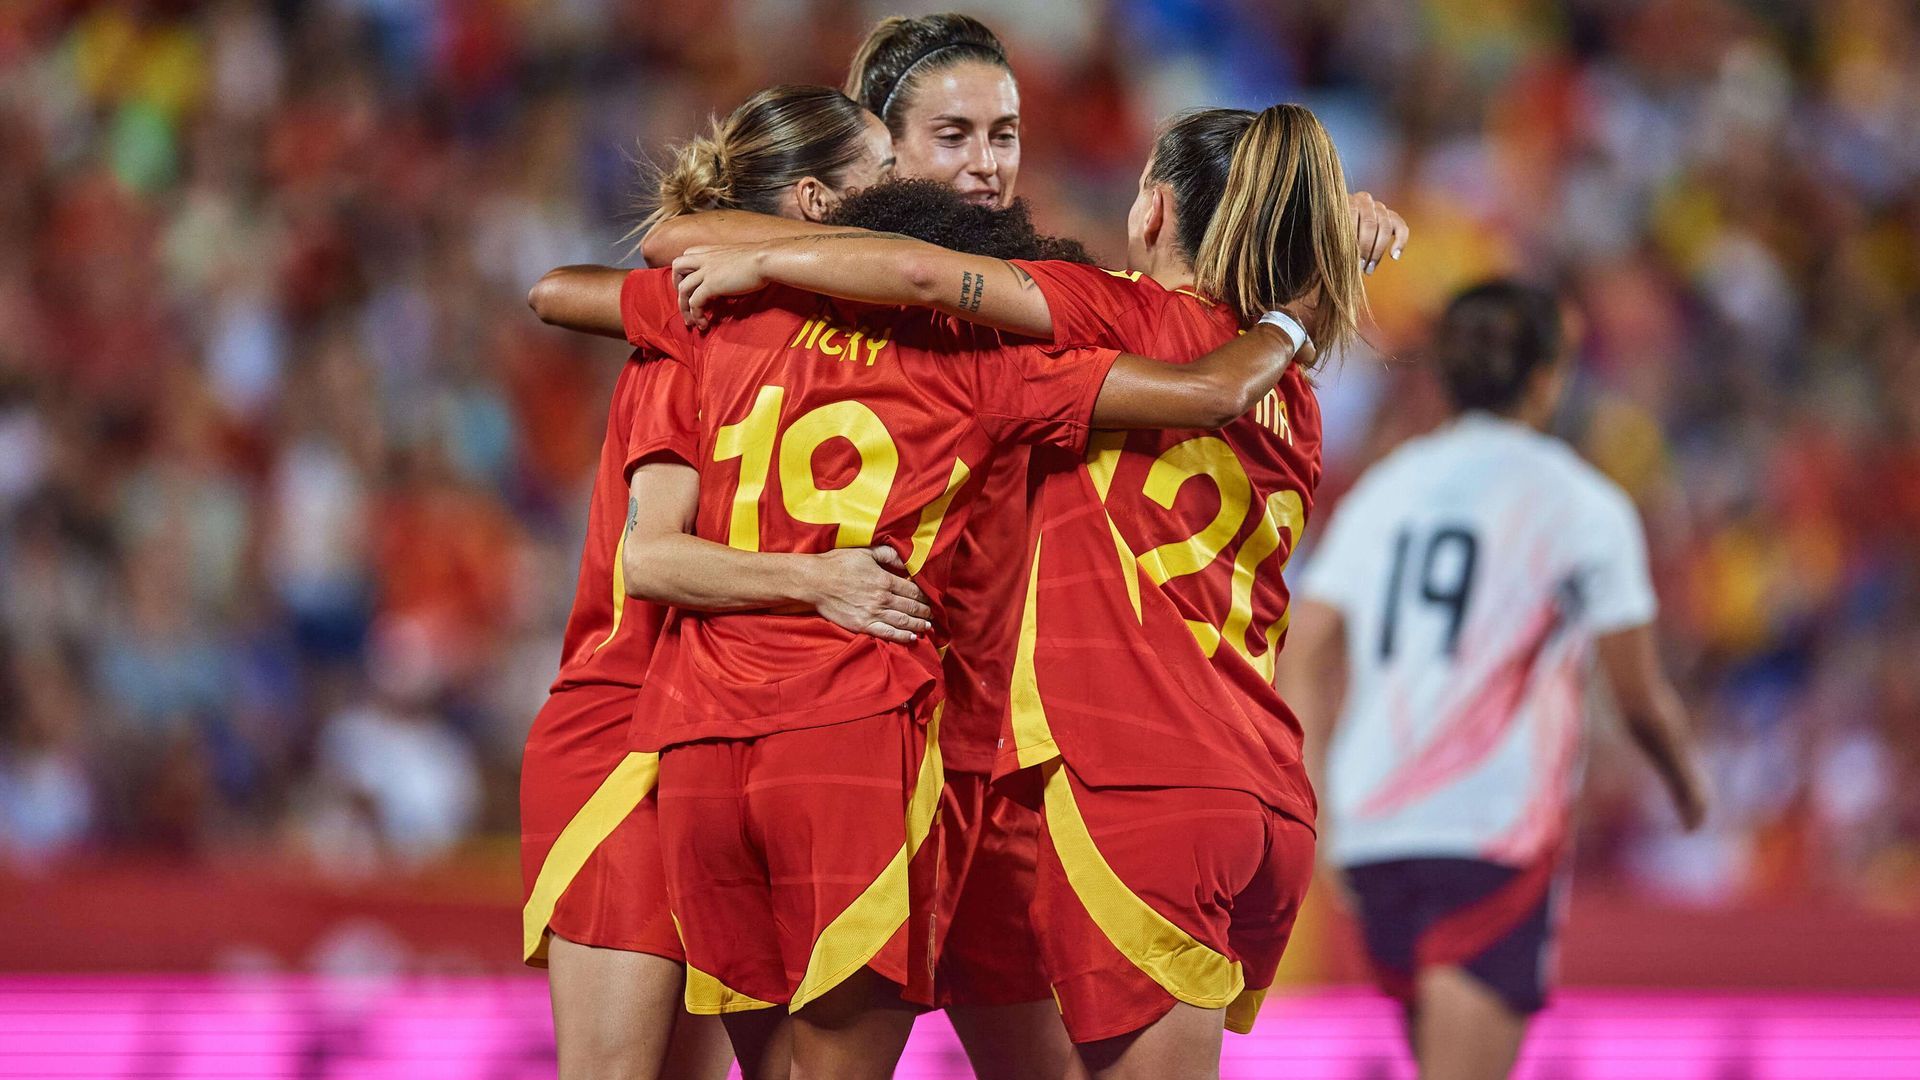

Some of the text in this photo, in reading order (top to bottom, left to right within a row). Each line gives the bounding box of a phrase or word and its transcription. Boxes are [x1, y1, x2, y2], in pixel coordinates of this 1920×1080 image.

[713, 384, 899, 553] 19
[1255, 387, 1293, 447] INA
[1136, 436, 1305, 686] 20
[1377, 526, 1476, 661] 19
